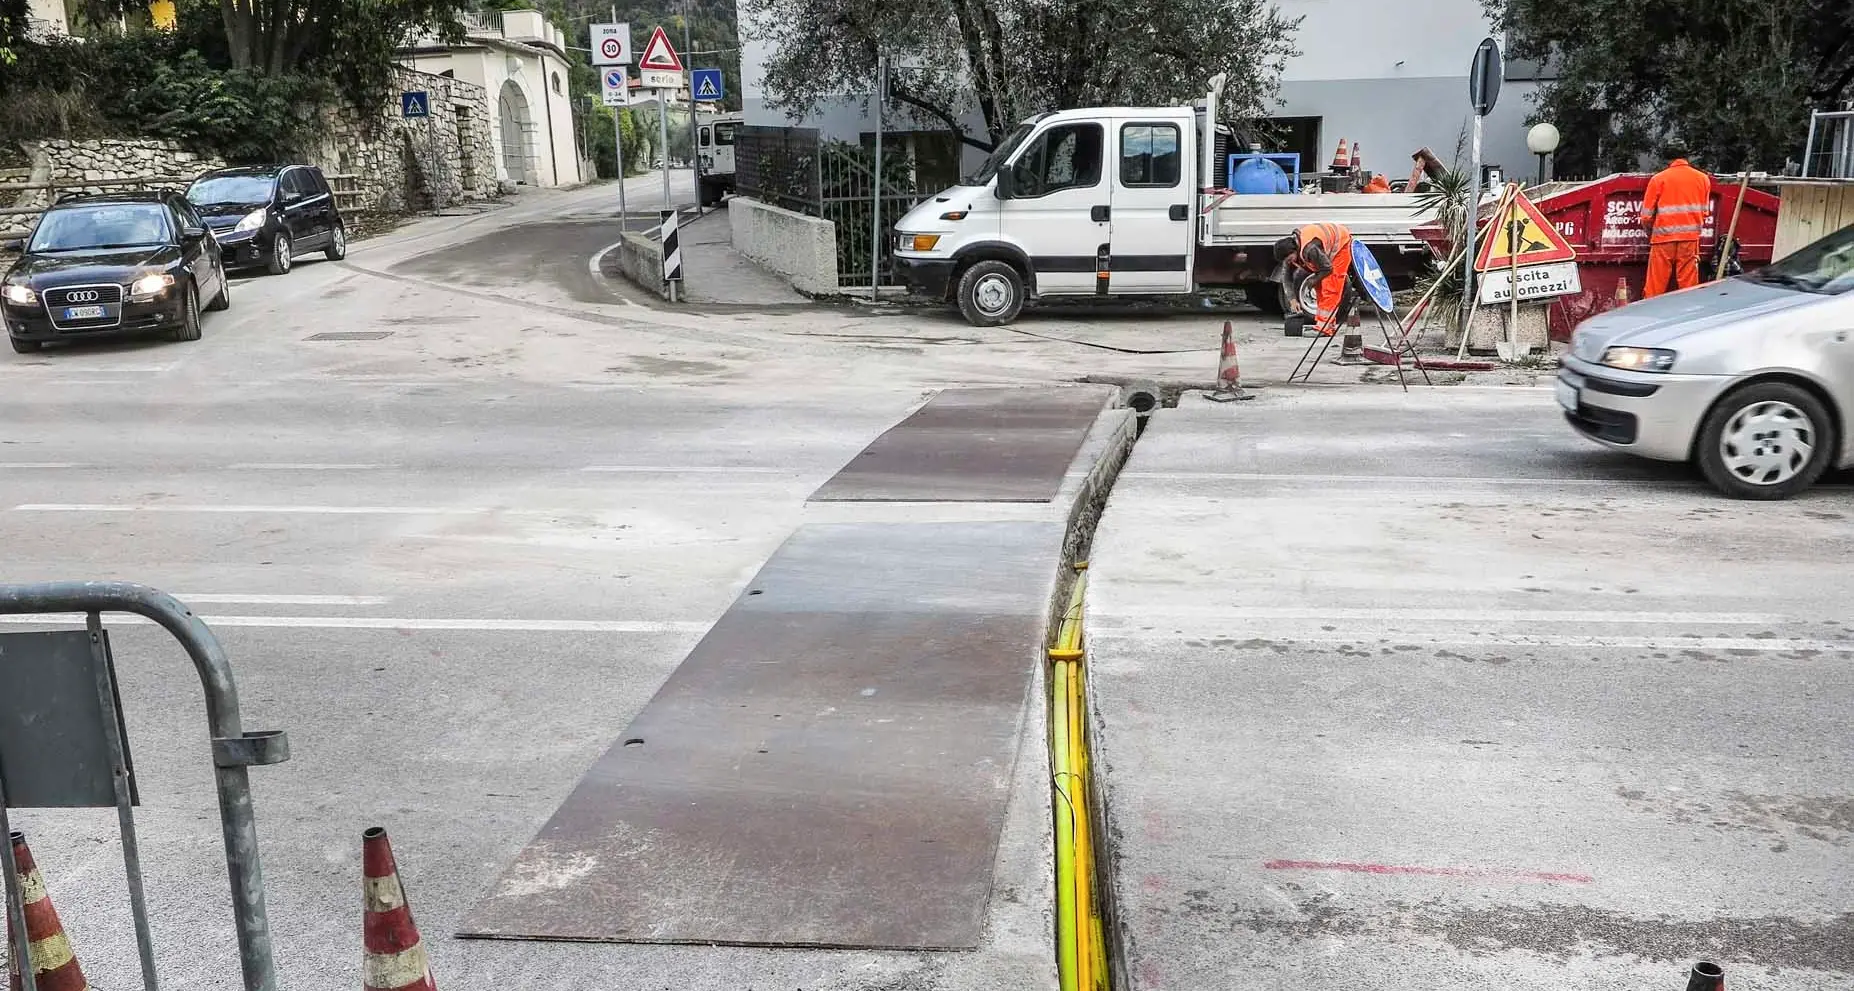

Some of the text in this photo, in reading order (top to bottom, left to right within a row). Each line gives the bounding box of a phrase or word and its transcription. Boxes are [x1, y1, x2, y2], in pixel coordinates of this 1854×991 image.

[606, 44, 617, 53] 30
[1506, 270, 1550, 284] uscita
[1494, 280, 1567, 299] auomezzi
